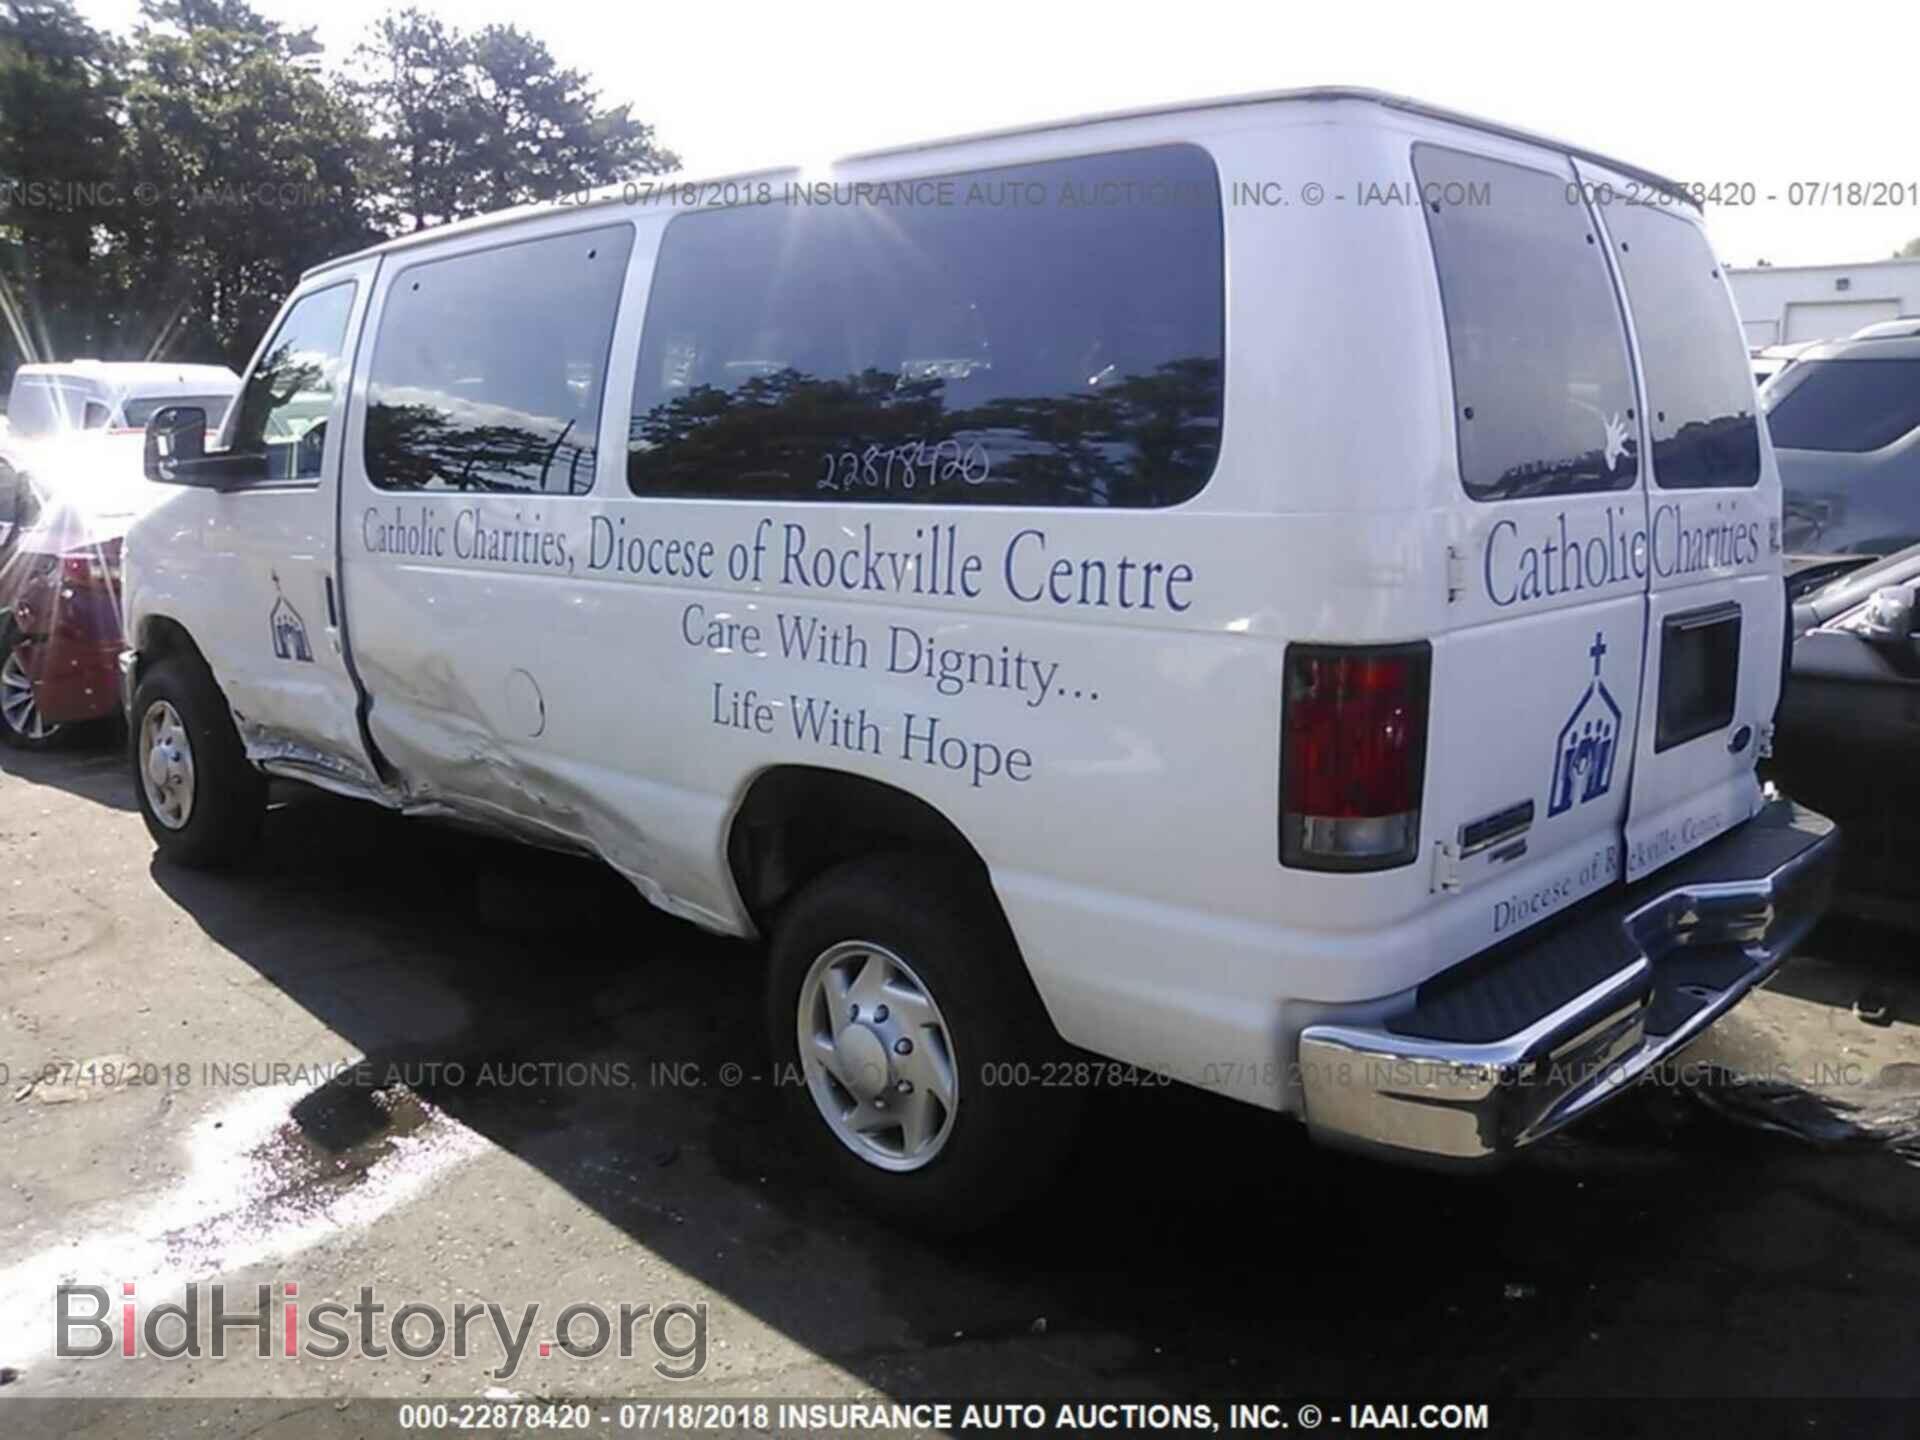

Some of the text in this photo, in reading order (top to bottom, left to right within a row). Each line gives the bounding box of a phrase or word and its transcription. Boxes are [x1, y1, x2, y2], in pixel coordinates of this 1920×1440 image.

[815, 440, 989, 490] 22878420
[362, 506, 1194, 612] Catholic Charities, Diocese of Rockville Centre
[1484, 501, 1759, 607] Catholic Charities
[682, 603, 1099, 708] Care With Dignity...
[712, 682, 1033, 789] Life With Hope
[1605, 828, 1677, 876] Rckville
